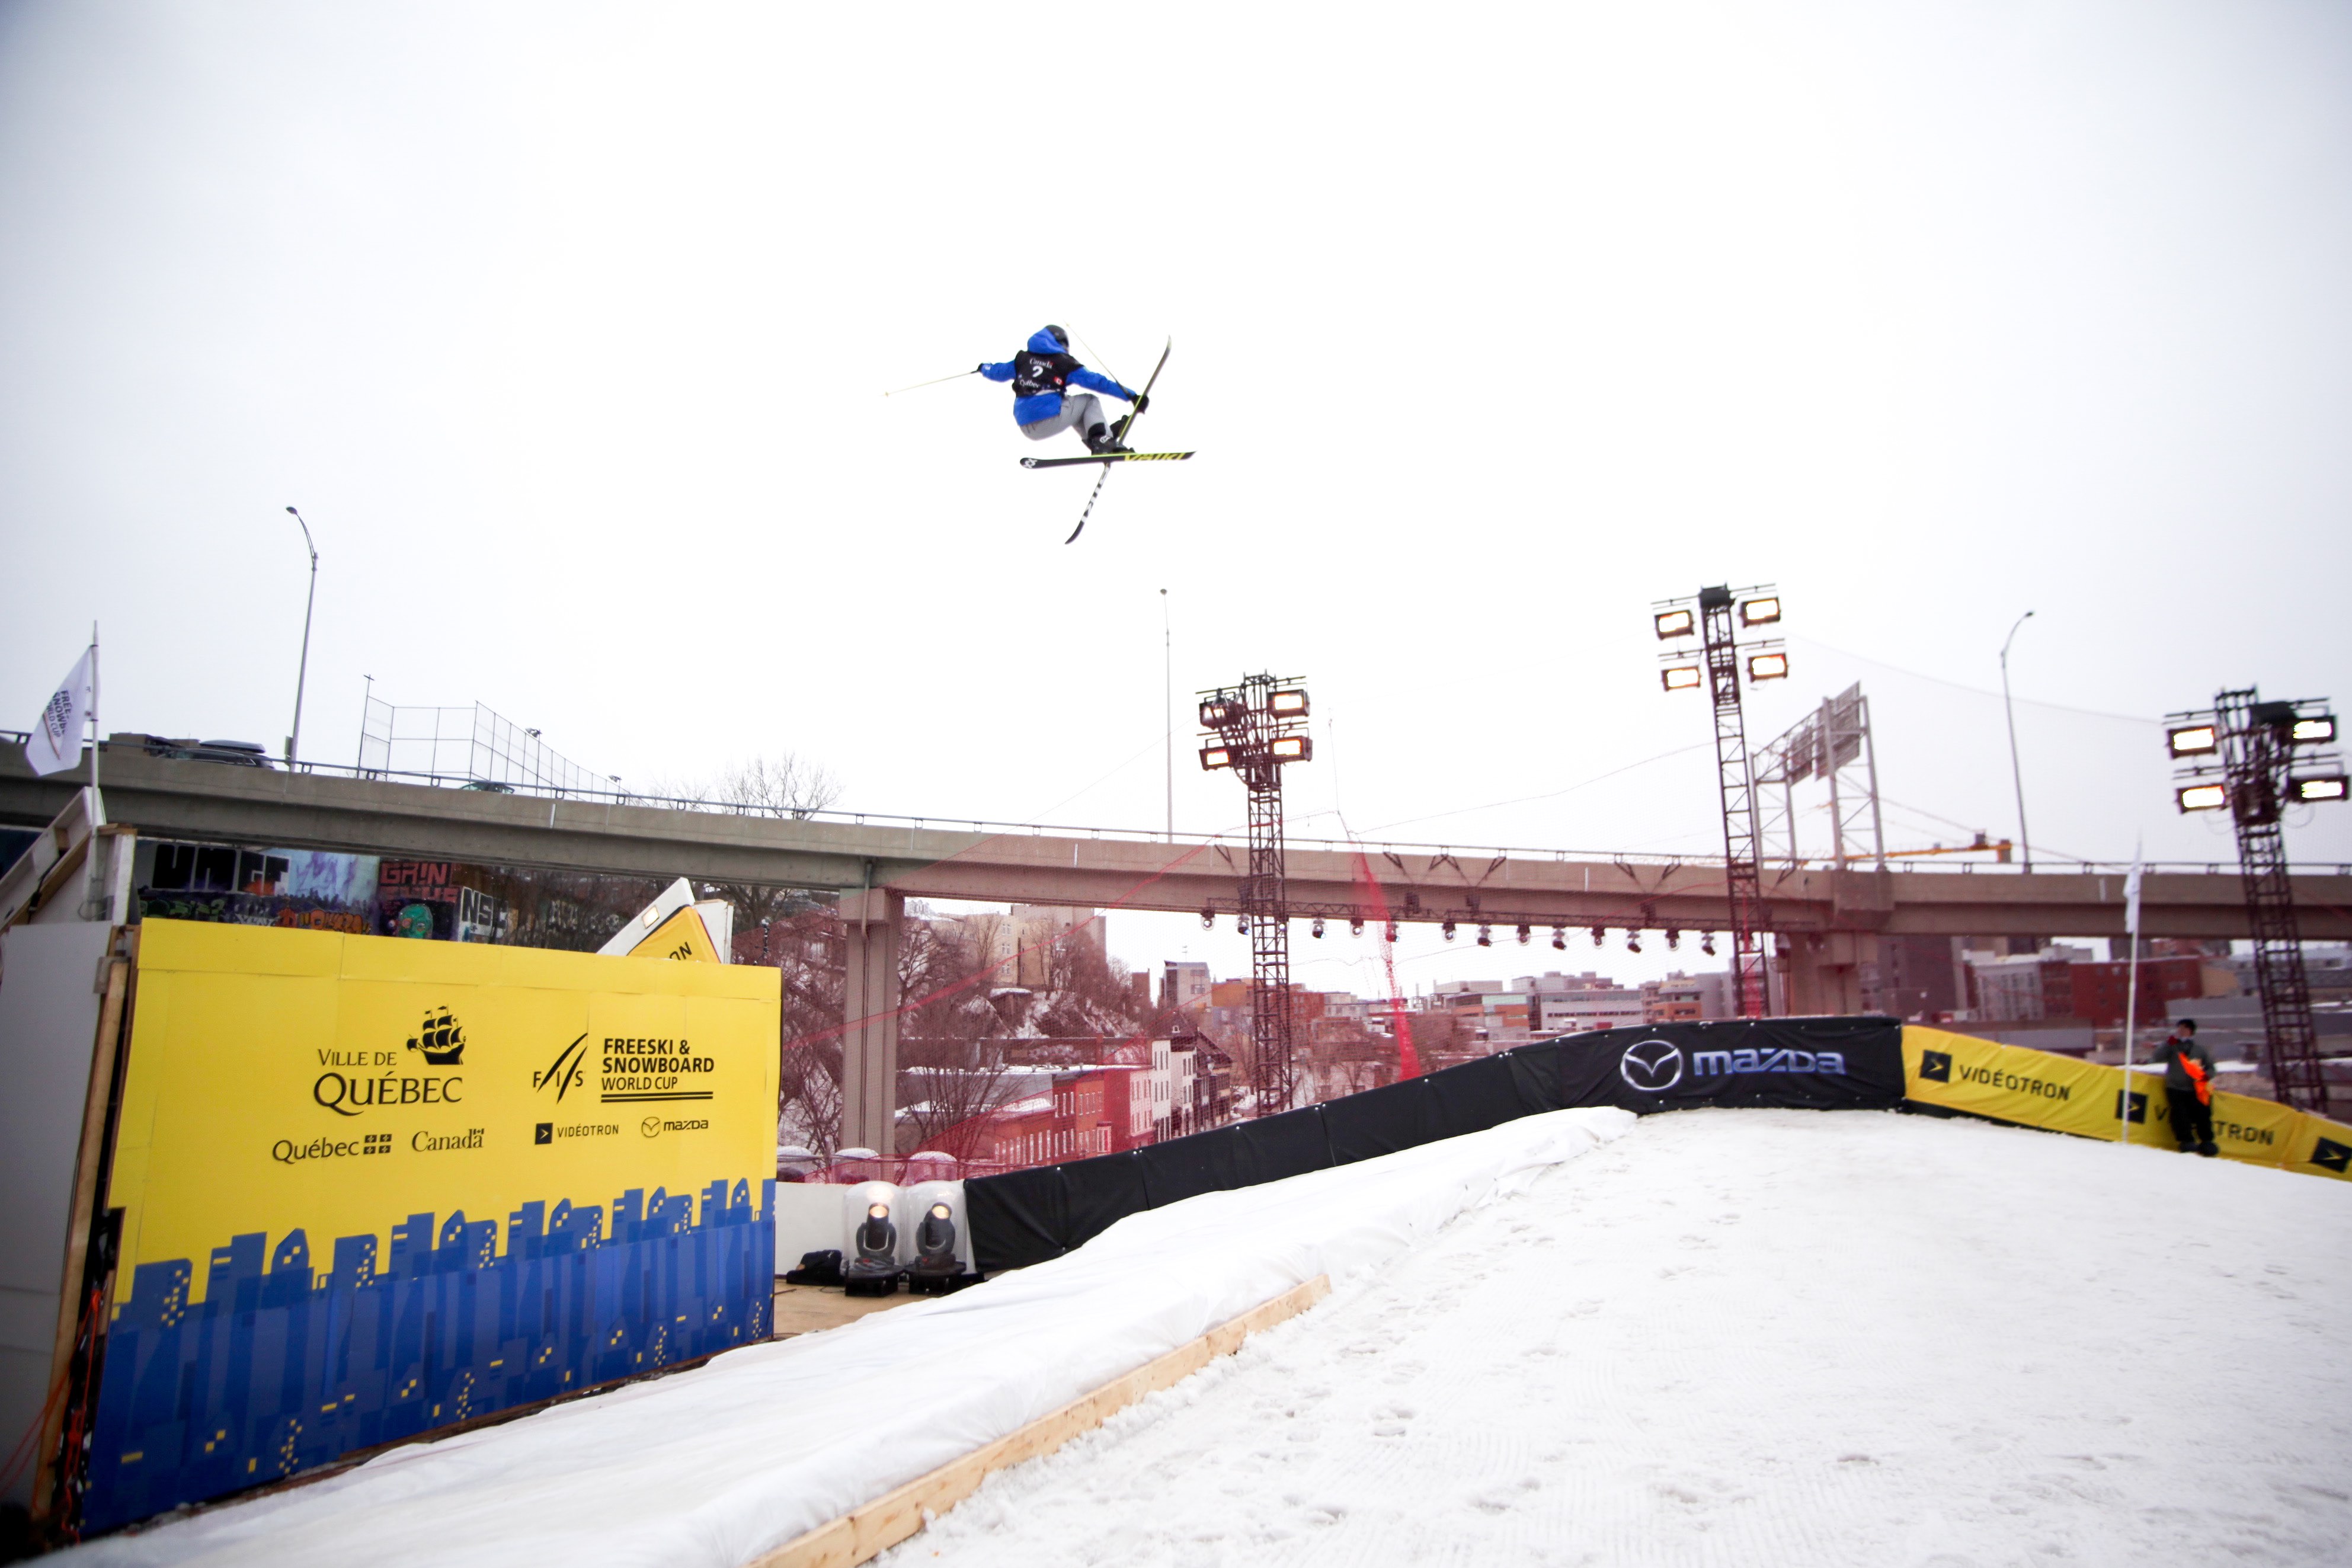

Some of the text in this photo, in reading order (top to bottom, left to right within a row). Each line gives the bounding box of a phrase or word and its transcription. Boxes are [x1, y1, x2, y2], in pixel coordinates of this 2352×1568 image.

[1032, 365, 1044, 377] 2
[603, 1038, 690, 1055] FREESKI &
[317, 1048, 397, 1066] VILLE DE
[602, 1057, 715, 1074] SNOWBOARD
[601, 1076, 678, 1091] WORLD CUP
[1959, 1065, 2071, 1101] VIDÉOTRON
[313, 1071, 463, 1116] QUÉBEC
[411, 1128, 484, 1152] Canada
[557, 1124, 619, 1139] VIDÉOTRON
[272, 1135, 360, 1164] Québec
